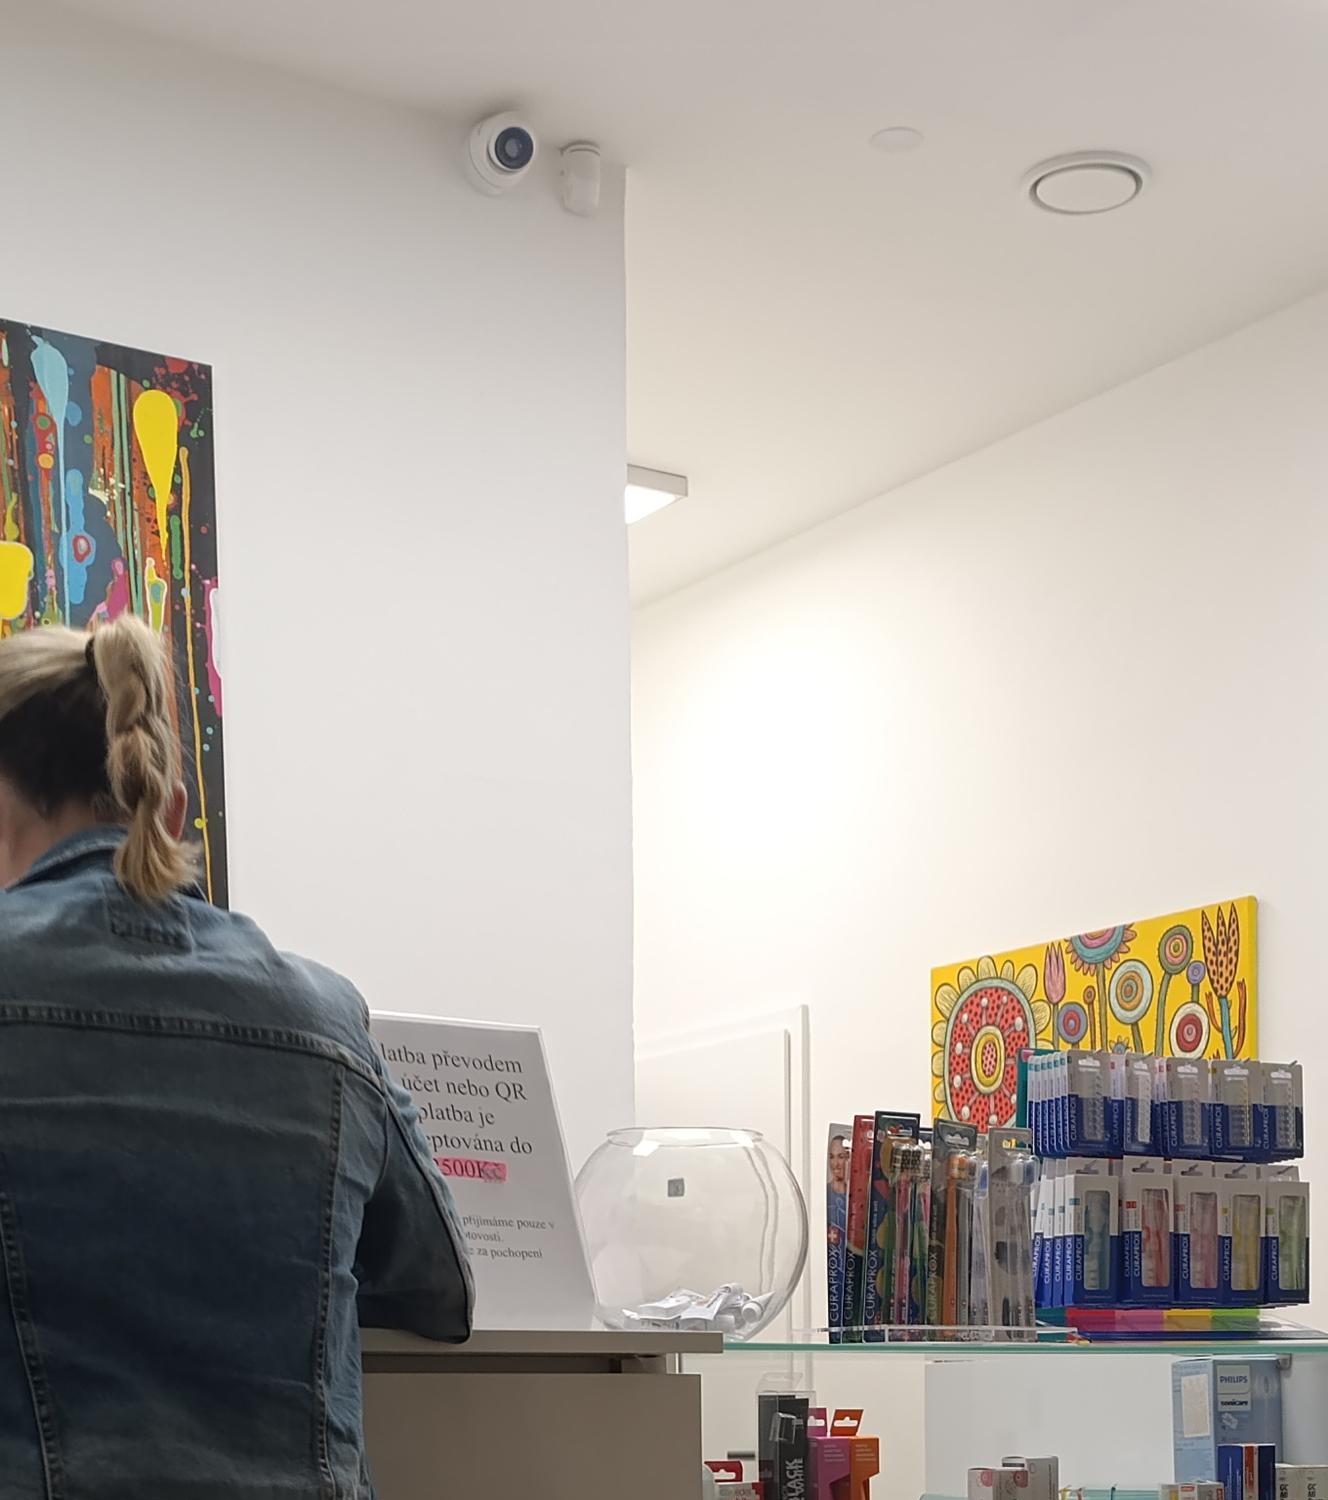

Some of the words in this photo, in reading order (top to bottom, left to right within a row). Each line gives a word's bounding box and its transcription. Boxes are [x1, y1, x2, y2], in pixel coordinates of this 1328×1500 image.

[380, 1043, 426, 1065] latba
[431, 1050, 523, 1073] převodem
[446, 1079, 490, 1097] nebo
[495, 1081, 528, 1102] QR
[418, 1102, 474, 1124] platba
[478, 1106, 495, 1129] je
[427, 1133, 505, 1153] ptována
[510, 1136, 533, 1155] do
[516, 1219, 546, 1230] pouze
[1075, 1237, 1083, 1281] CURAPROX
[829, 1248, 840, 1322] CURAPROX
[844, 1251, 856, 1321] CURAPROX
[865, 1250, 879, 1320] CURAPROX
[928, 1252, 938, 1320] CURAPROX
[1219, 1375, 1248, 1384] PHILIPS
[1307, 1483, 1317, 1491] GC
